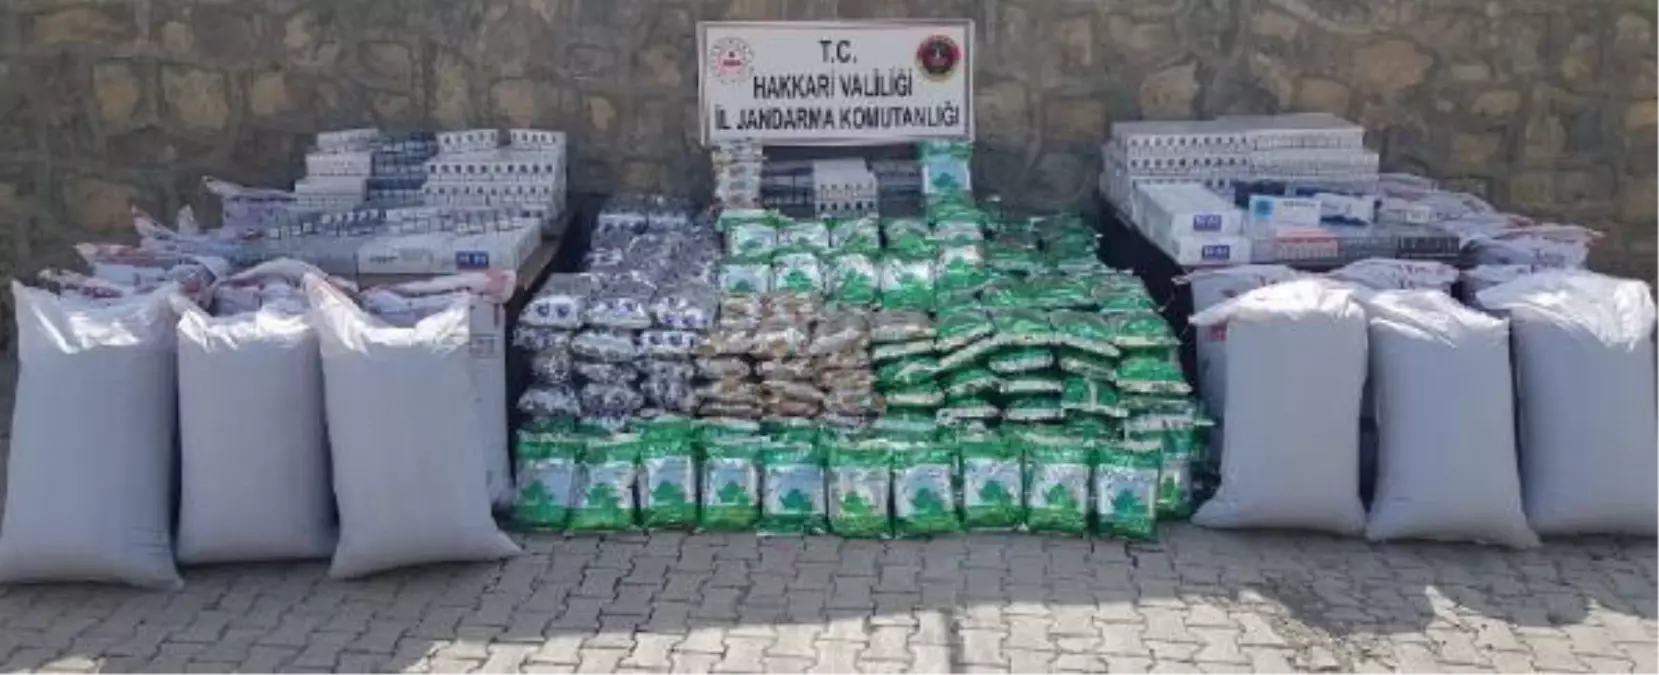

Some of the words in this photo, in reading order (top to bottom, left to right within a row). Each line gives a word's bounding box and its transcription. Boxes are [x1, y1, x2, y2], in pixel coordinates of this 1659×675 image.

[819, 40, 857, 63] T.C.
[753, 70, 835, 99] HAKKARİ
[840, 68, 912, 96] VALİLİĞİ
[715, 104, 731, 130] İL
[737, 106, 834, 130] JANDARMA
[839, 100, 959, 130] KOMUTANLIĞI
